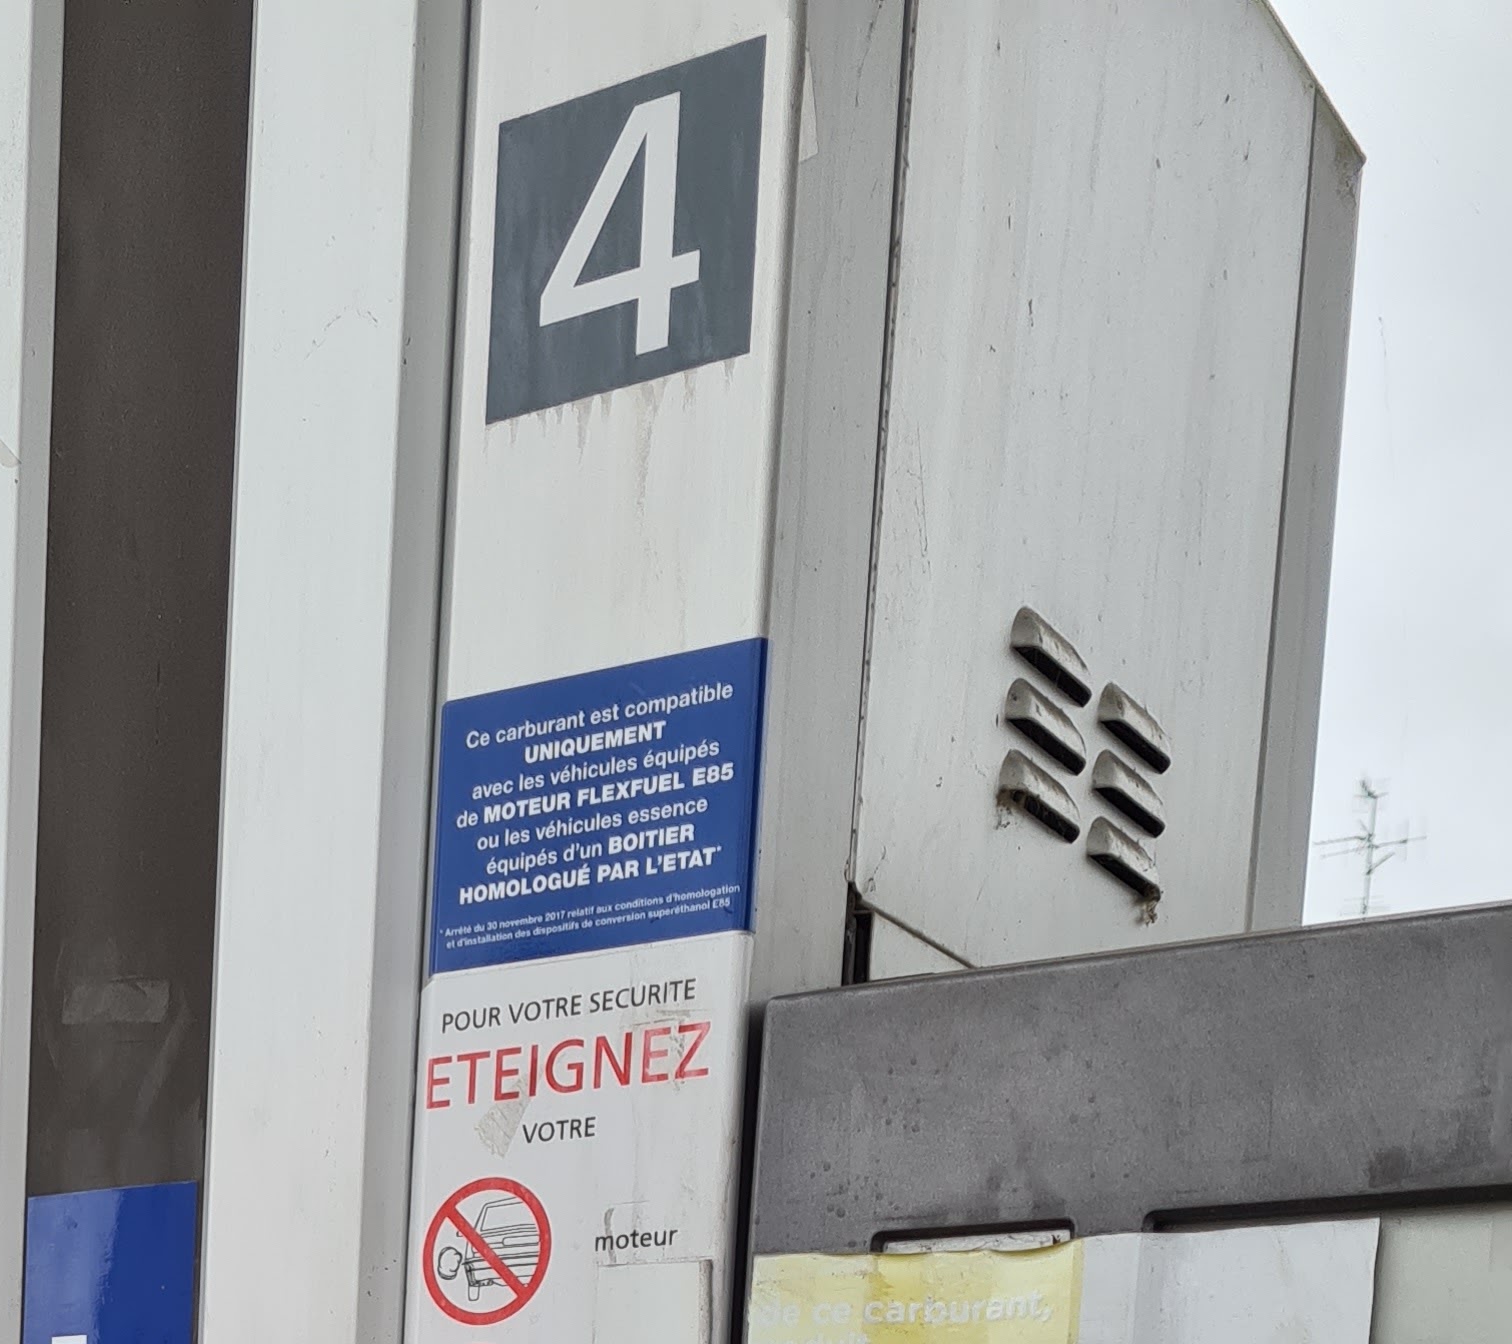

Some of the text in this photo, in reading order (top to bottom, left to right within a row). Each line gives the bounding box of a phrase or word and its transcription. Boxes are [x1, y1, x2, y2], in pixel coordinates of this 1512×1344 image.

[539, 91, 700, 355] 4
[496, 682, 733, 743] carburant compatible
[525, 720, 666, 763] UNIQUEMENT
[550, 739, 719, 785] véhicules équipés
[484, 762, 733, 824] MOTEUR FLEXFUEL E85
[536, 799, 708, 840] véhicules essence
[486, 824, 694, 876] équipés BOITIER
[460, 860, 639, 905] HOMOLOGUÉ PAR
[442, 978, 696, 1034] POUR VOTRE SECURITE
[427, 1021, 710, 1109] ETEIGNEZ
[522, 1116, 596, 1143] VOTRE
[595, 1229, 678, 1253] moteur
